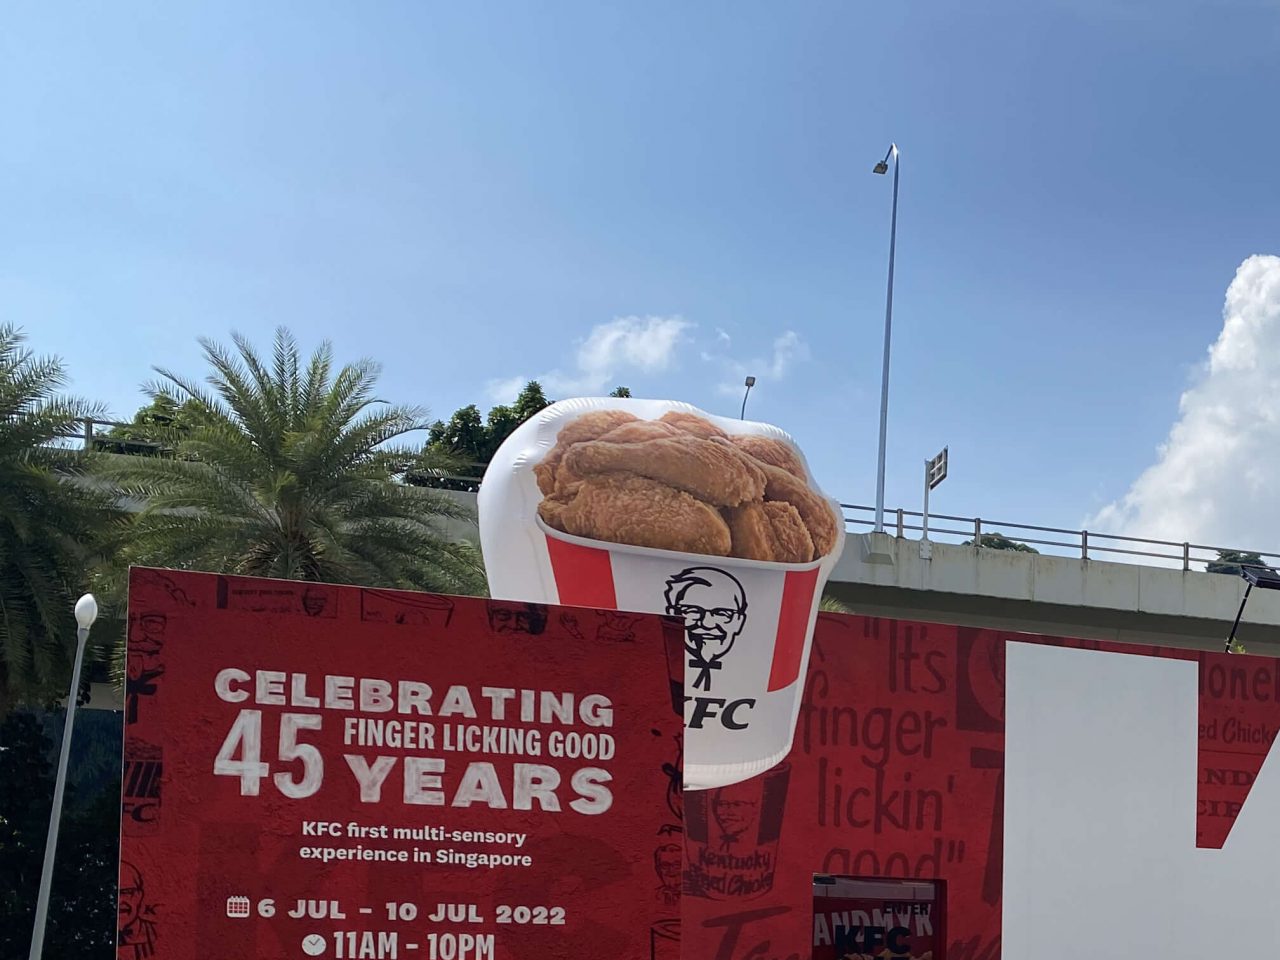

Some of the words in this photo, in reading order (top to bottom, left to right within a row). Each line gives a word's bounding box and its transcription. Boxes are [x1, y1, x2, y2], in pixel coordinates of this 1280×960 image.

[214, 667, 614, 728] CELEBRATING
[345, 718, 434, 749] FINGER
[443, 724, 540, 755] LICKING
[549, 731, 615, 760] GOOD
[802, 670, 948, 769] finger
[214, 710, 323, 798] 45
[343, 753, 614, 815] YEARS
[818, 757, 955, 834] lickin'
[302, 821, 342, 837] KFC
[347, 822, 389, 839] first
[393, 826, 527, 848] multi-sensory
[300, 845, 408, 862] experience
[414, 848, 430, 862] in
[436, 849, 531, 868] Singapore
[258, 899, 275, 917] 6
[288, 900, 345, 919] JUL
[386, 903, 417, 920] 10
[429, 904, 483, 922] JUL
[496, 906, 565, 924] 2022
[334, 932, 397, 959] 11AM
[428, 933, 494, 960] 10PM
[835, 925, 912, 955] KFC
